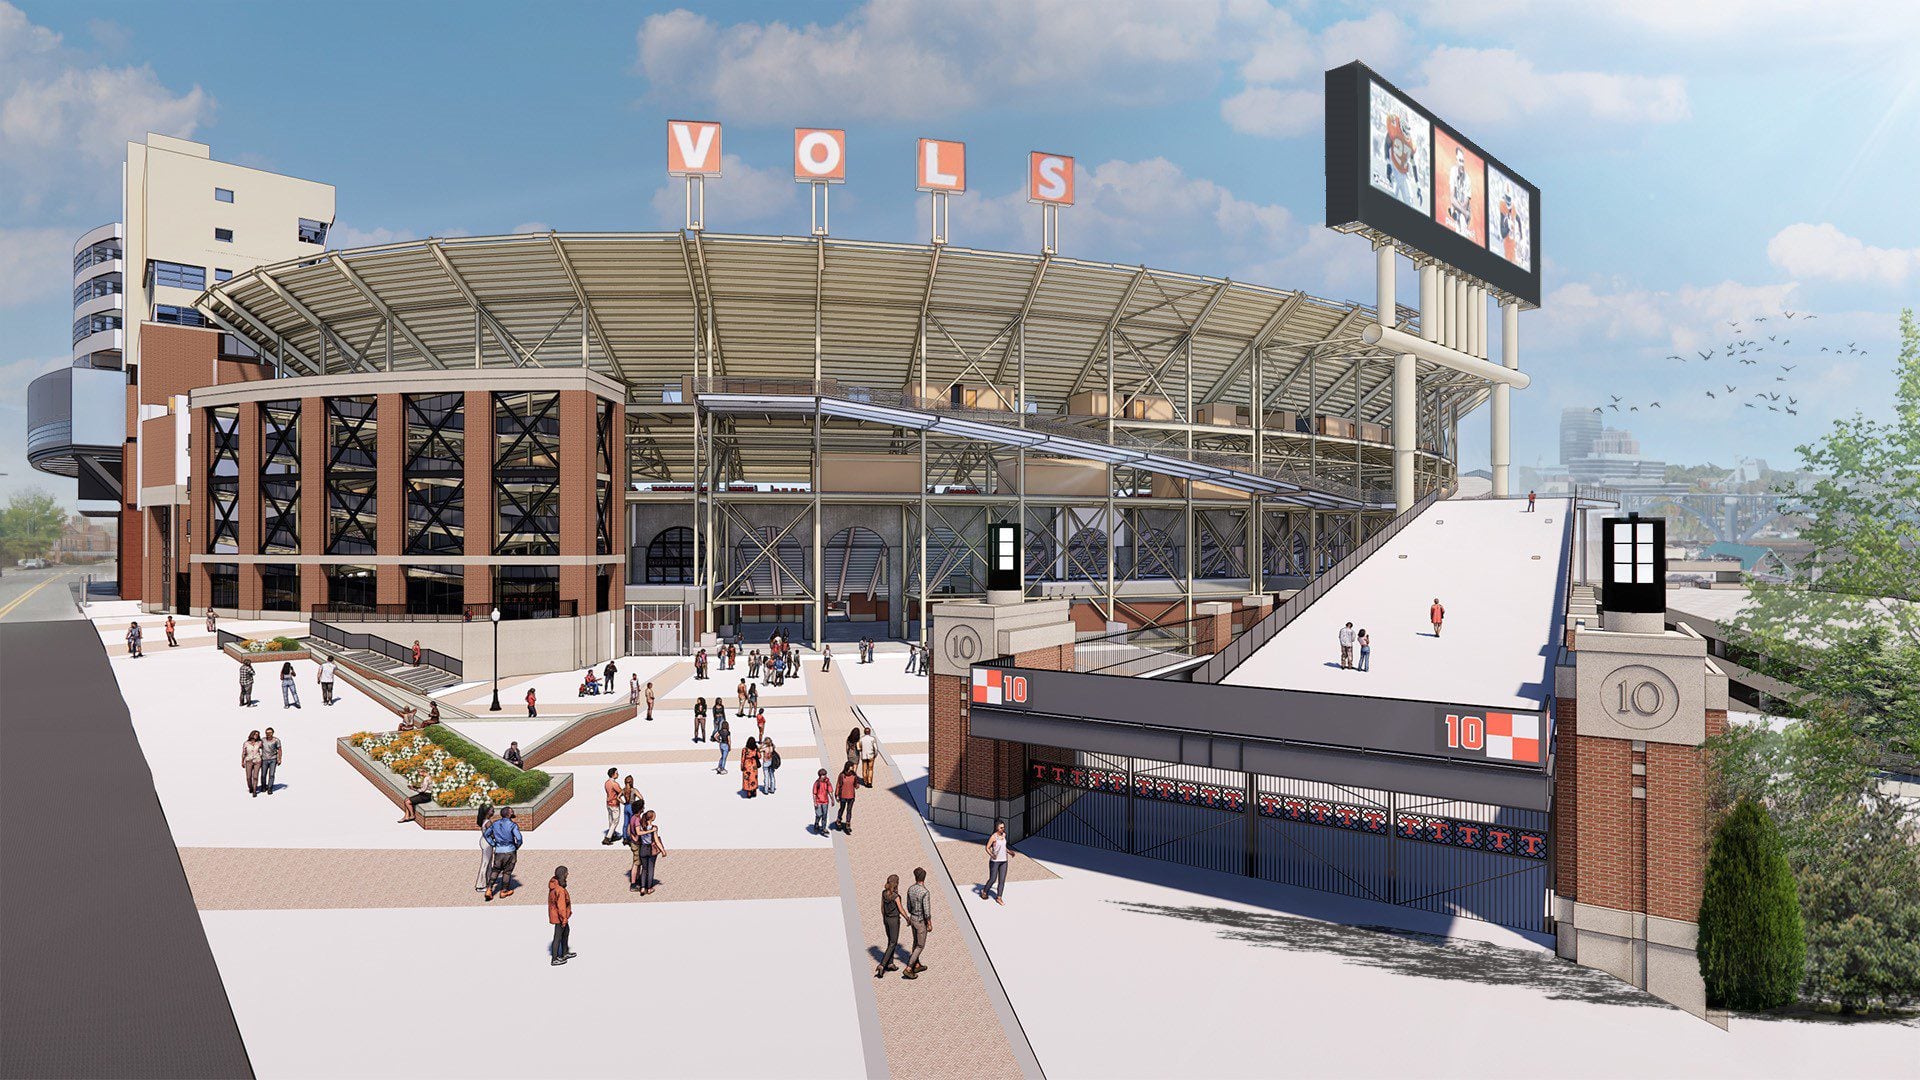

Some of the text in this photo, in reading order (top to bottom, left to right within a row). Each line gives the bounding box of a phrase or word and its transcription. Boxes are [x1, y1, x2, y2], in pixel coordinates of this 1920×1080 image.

[952, 635, 975, 660] 10
[1003, 675, 1028, 703] 10
[1617, 679, 1664, 714] 10
[1445, 714, 1484, 750] 10
